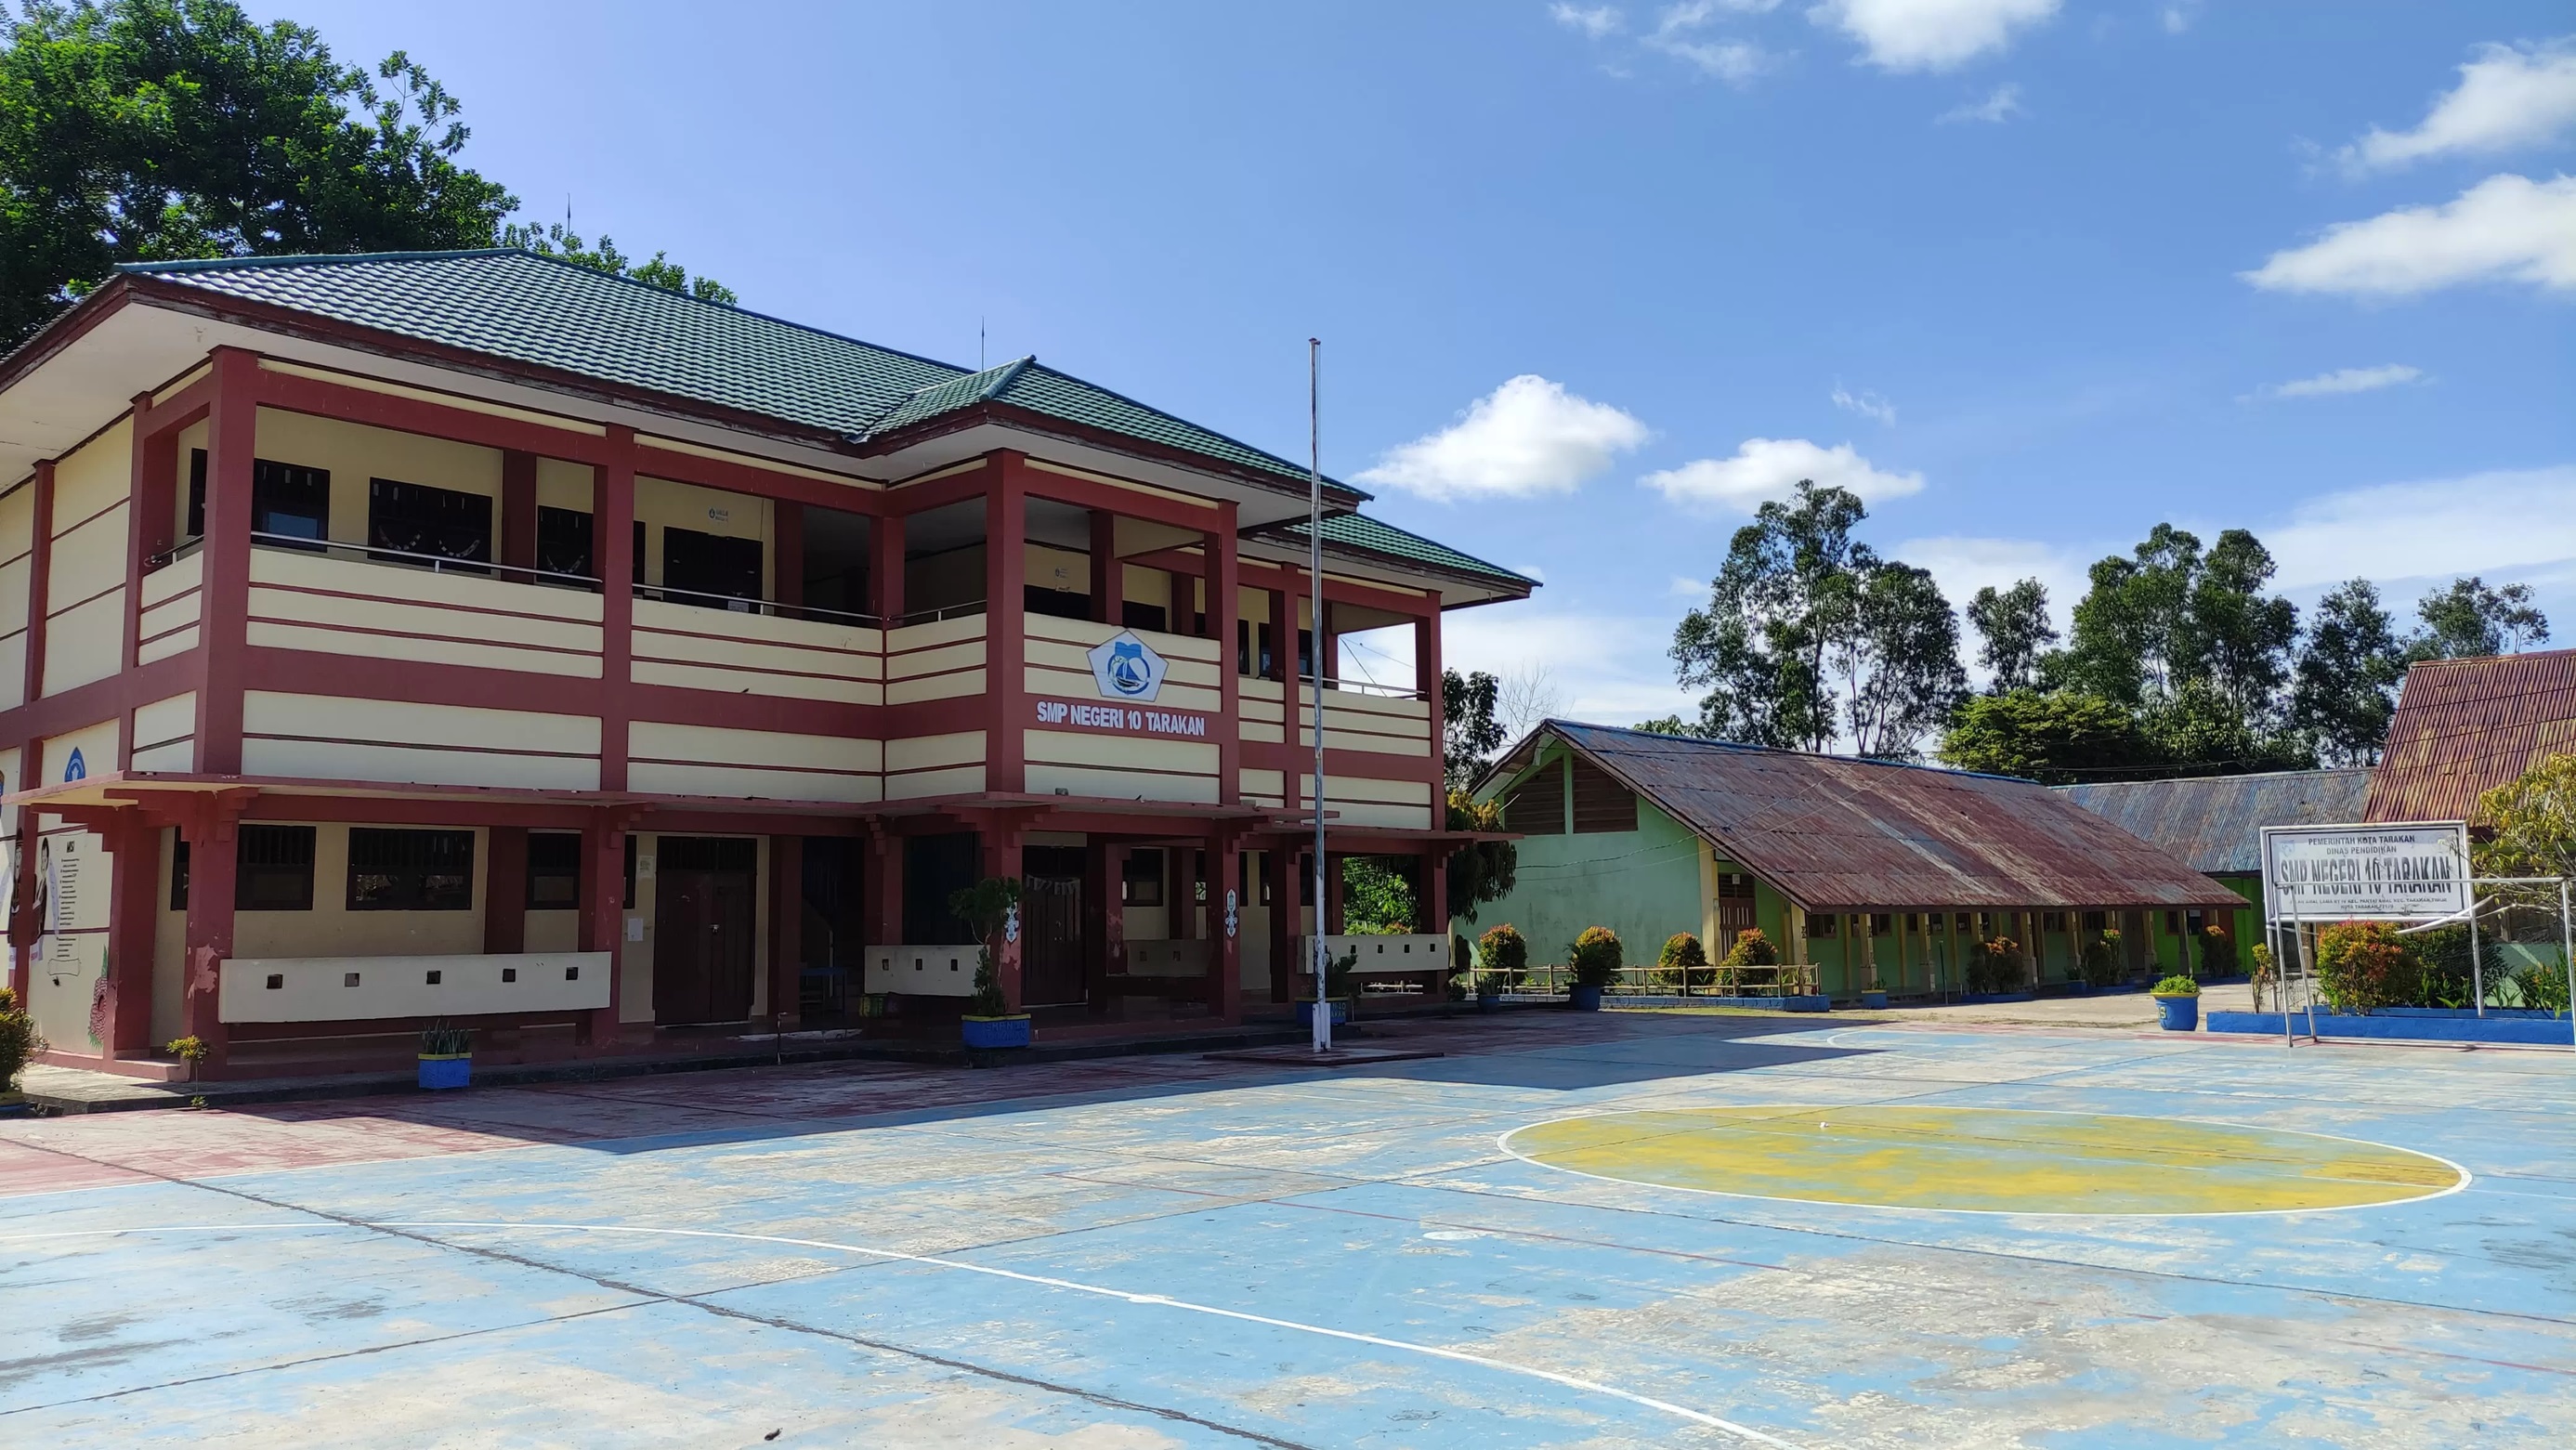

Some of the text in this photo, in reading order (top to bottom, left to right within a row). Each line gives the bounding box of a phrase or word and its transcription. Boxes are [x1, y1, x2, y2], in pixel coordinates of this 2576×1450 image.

[1037, 701, 1205, 736] SMP NEGERI 10 TARAKAN
[2350, 845, 2397, 855] PENDIDIKAN
[2358, 836, 2377, 844] KOTA
[2379, 835, 2415, 843] TARAKAN
[2281, 856, 2452, 895] SMP NEGERI 10 TARAKAN
